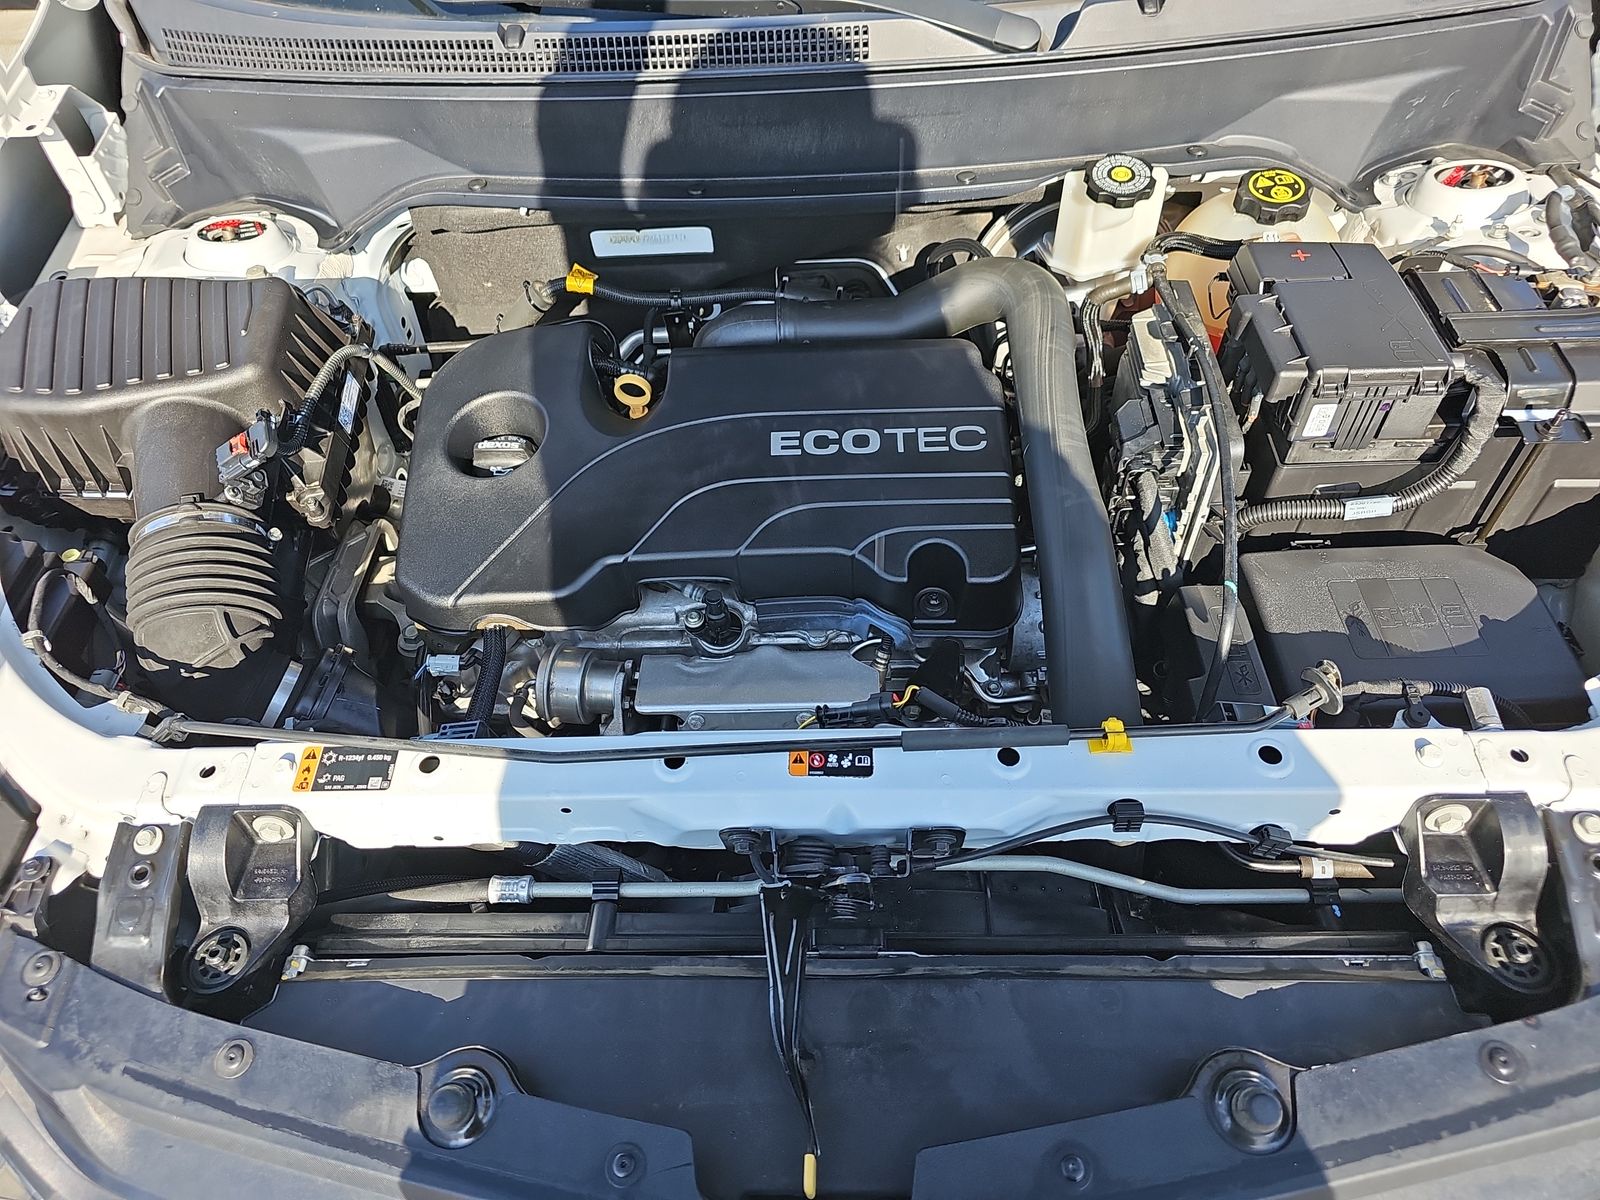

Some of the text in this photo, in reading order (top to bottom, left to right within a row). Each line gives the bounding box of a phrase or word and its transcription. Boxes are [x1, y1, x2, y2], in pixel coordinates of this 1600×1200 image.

[478, 440, 521, 449] dexos
[770, 425, 988, 456] ECOTEC
[332, 774, 346, 782] PAG
